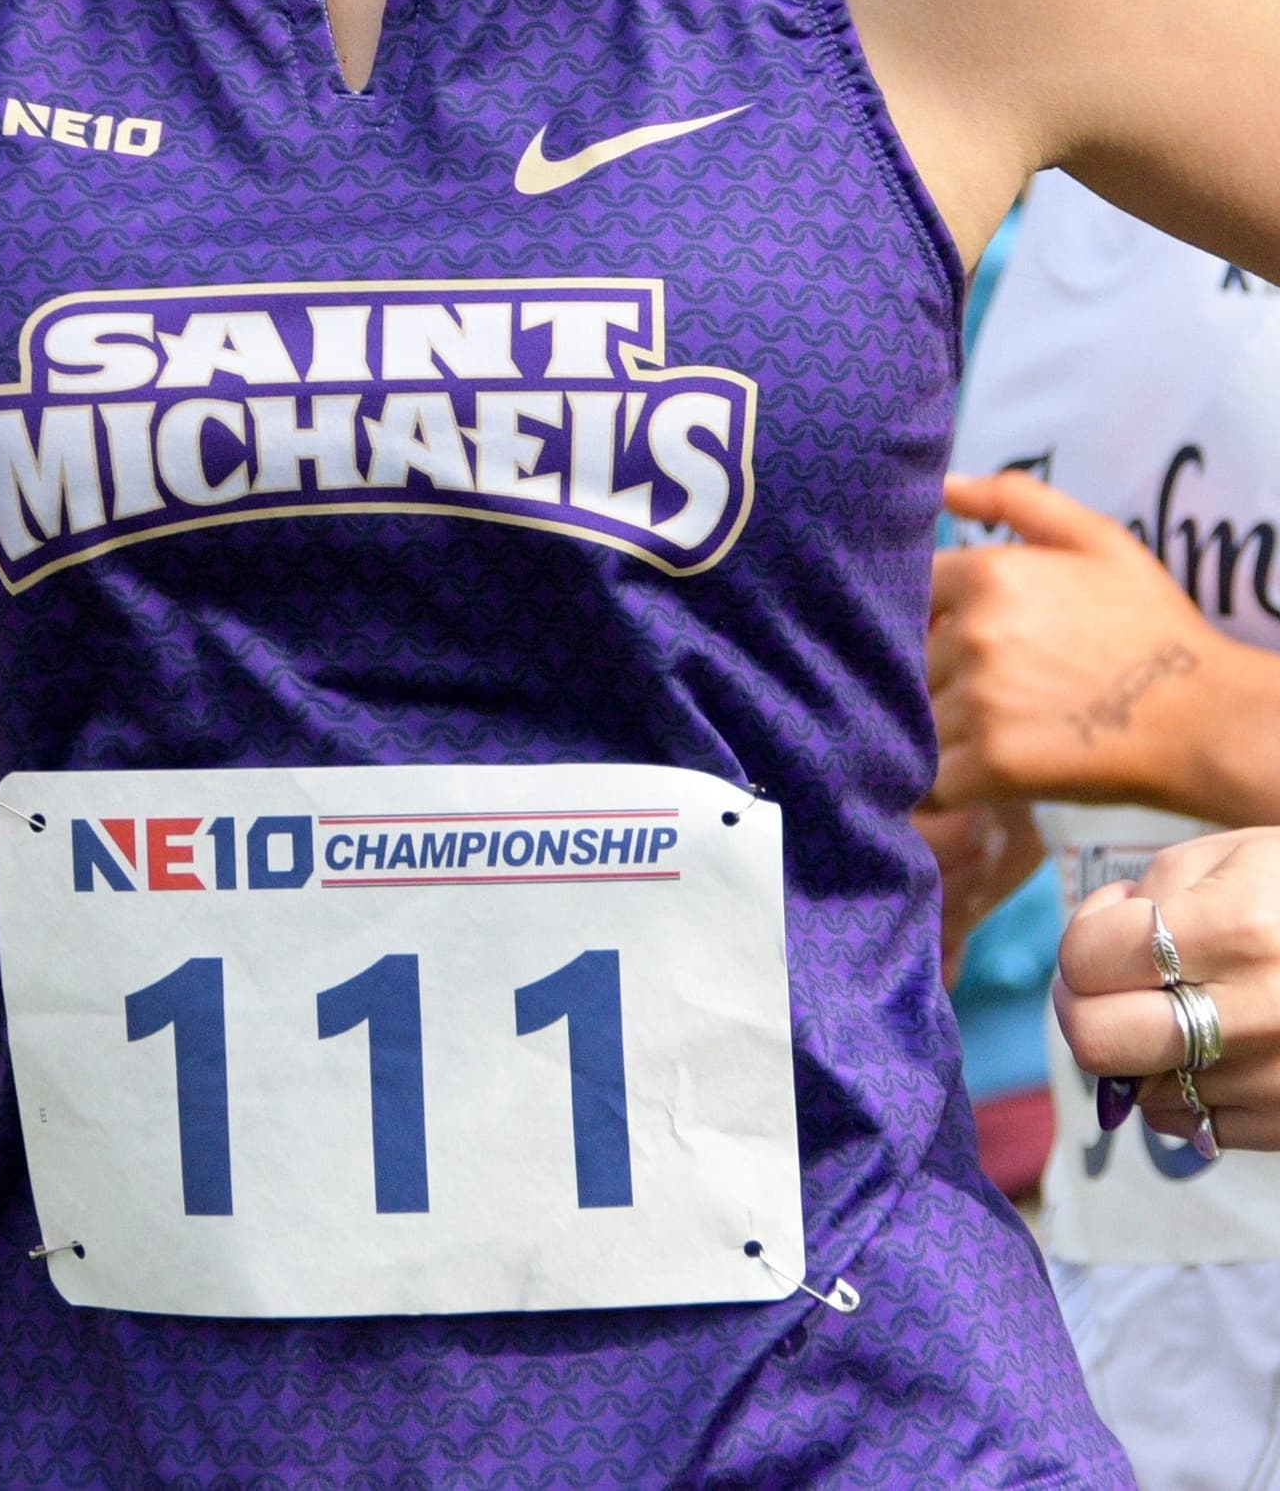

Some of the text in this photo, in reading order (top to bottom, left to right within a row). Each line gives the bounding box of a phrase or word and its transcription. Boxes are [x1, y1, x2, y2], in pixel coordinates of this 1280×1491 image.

[2, 98, 163, 157] NE10
[45, 301, 640, 394] SAINT
[72, 816, 679, 892] NE10 CHAMPIONSHIP
[124, 949, 634, 1216] 111
